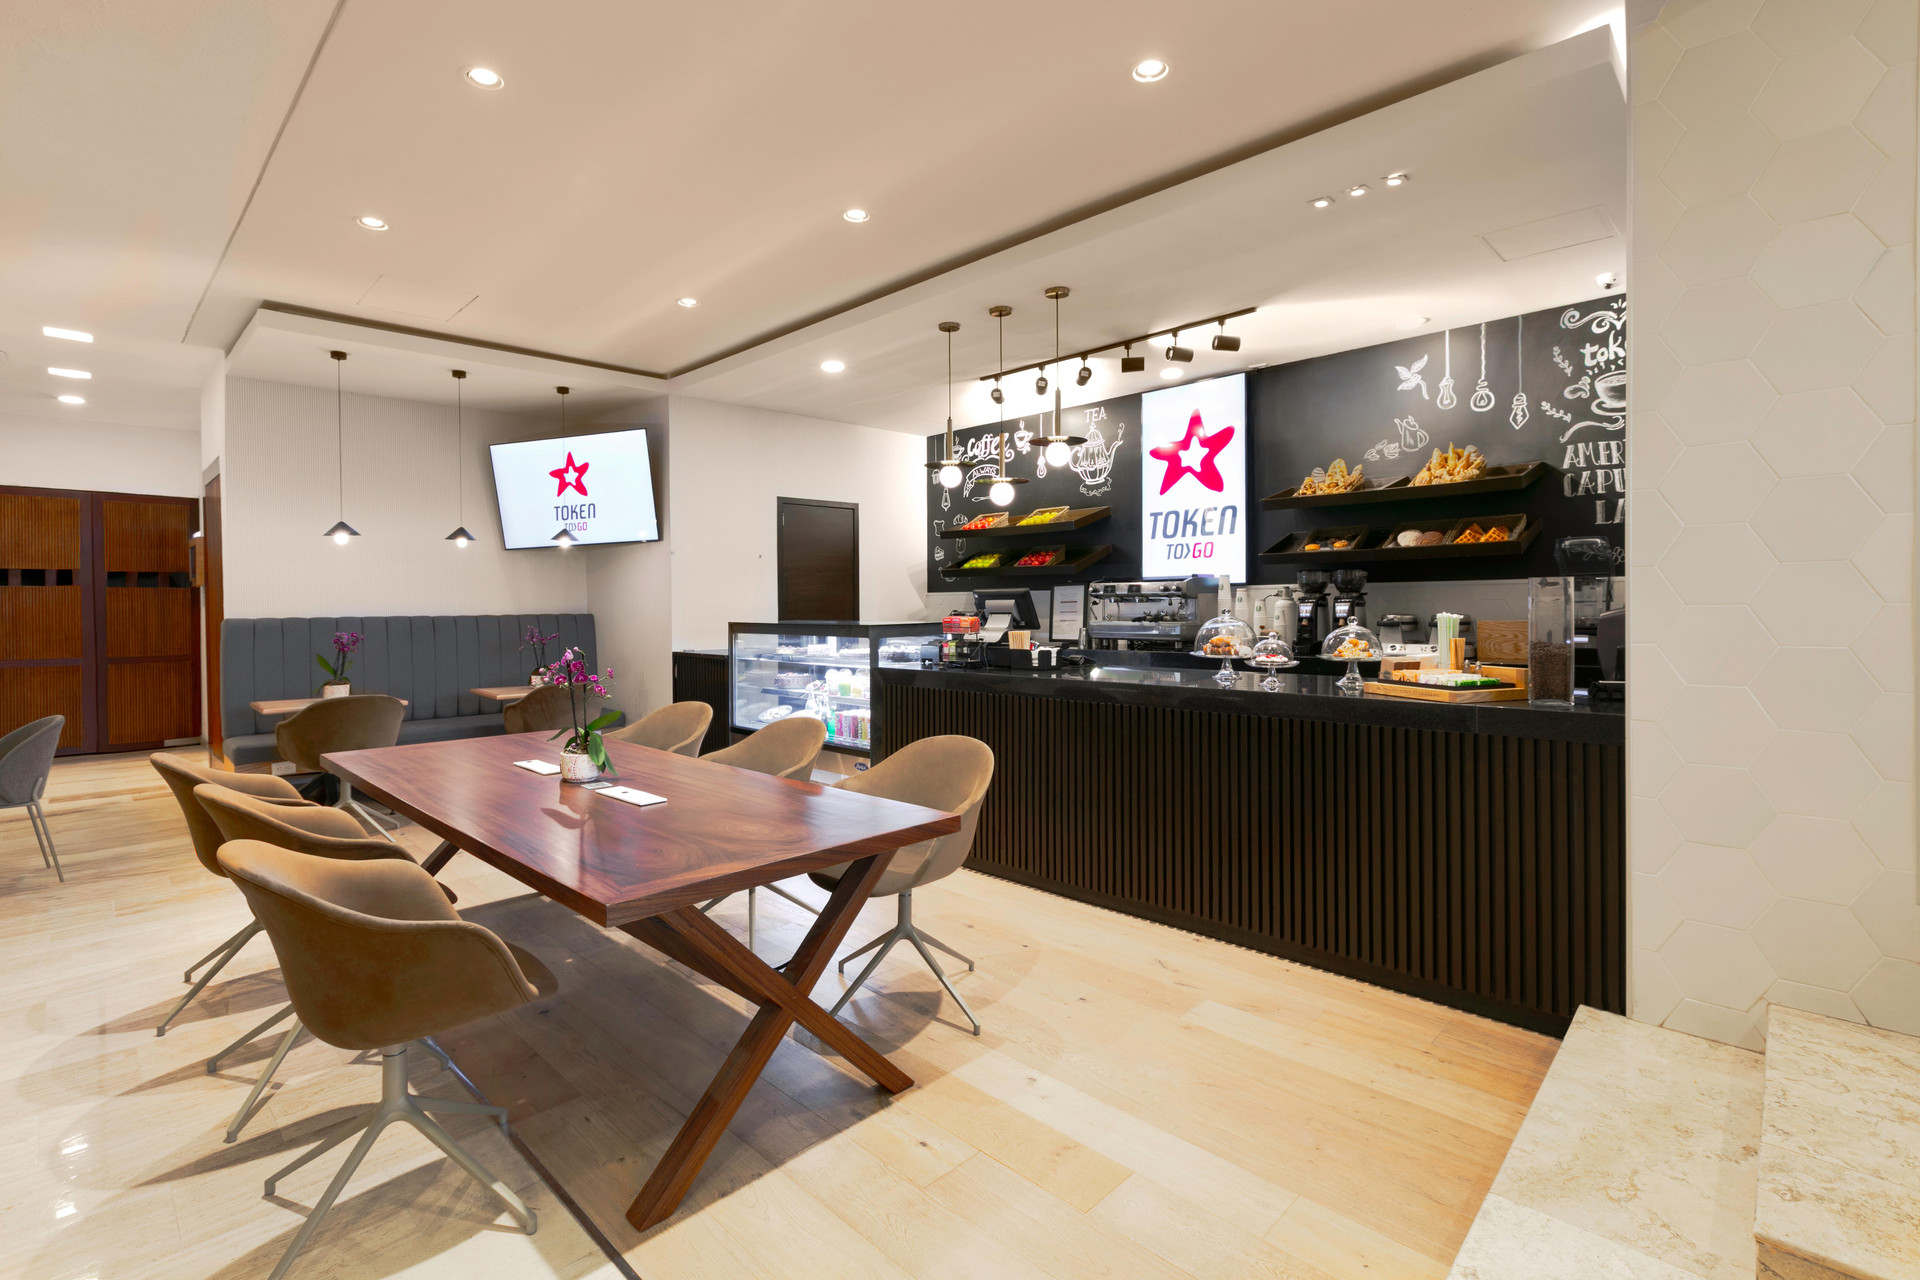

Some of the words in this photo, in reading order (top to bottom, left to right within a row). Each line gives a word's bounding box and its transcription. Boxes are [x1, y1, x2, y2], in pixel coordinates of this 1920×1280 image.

[1580, 330, 1626, 367] tok
[1084, 406, 1107, 423] TEA
[1562, 439, 1626, 469] AMER
[972, 466, 997, 478] ALWAYS
[554, 503, 596, 521] TOKEN
[1149, 505, 1238, 540] TOKEN
